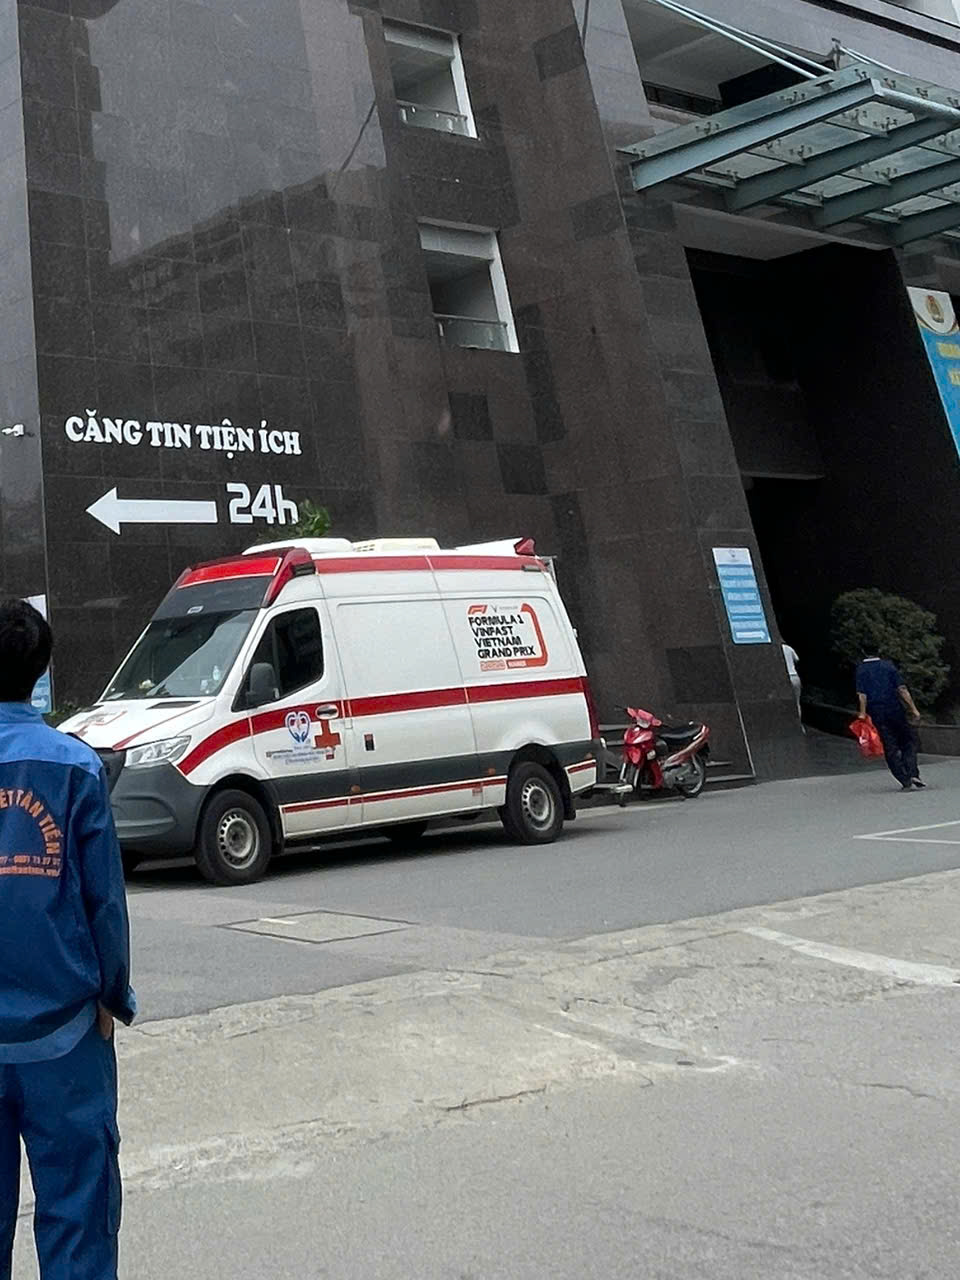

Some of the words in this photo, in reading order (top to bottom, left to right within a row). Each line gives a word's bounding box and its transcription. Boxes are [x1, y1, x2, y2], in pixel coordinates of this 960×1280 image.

[65, 408, 143, 445] CĂNG
[146, 421, 191, 448] TIN
[196, 418, 255, 459] TIỆN
[258, 420, 302, 455] ÍCH
[226, 482, 299, 525] 24h
[468, 615, 517, 626] FORMULA
[517, 614, 524, 624] 1
[471, 626, 513, 637] VINFAST
[474, 636, 522, 648] VIETNAM
[478, 648, 512, 658] GRAND
[513, 646, 536, 656] PRIX
